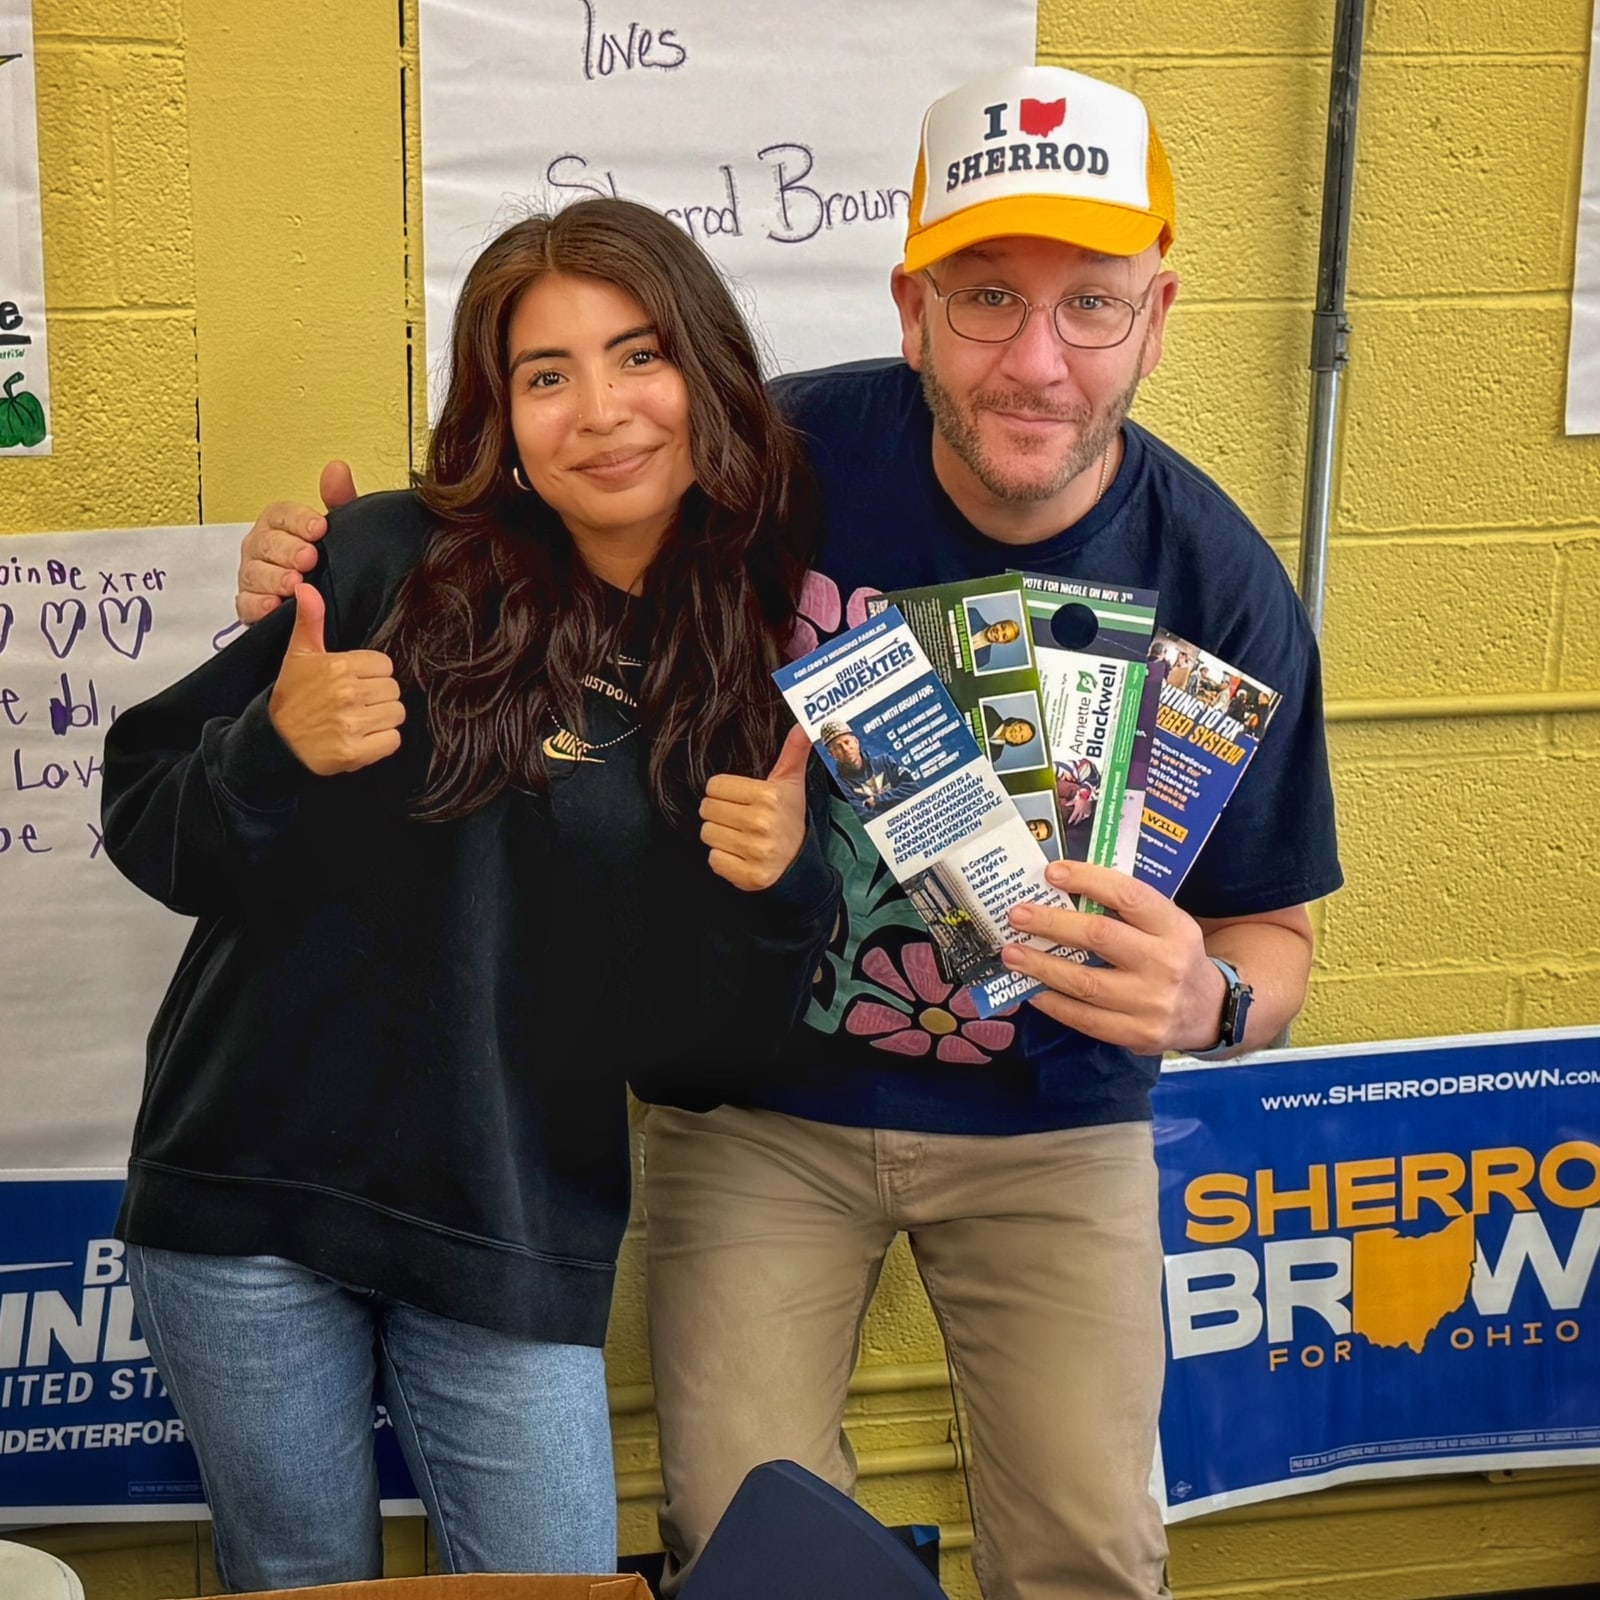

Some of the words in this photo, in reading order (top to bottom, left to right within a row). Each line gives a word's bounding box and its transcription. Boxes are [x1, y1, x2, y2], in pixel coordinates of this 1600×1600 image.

[577, 0, 687, 80] loves
[984, 103, 1008, 141] I
[946, 142, 1109, 192] SHERROD
[757, 144, 911, 244] Brown
[1022, 577, 1041, 590] VOTE
[1043, 580, 1059, 592] FOR
[1060, 582, 1087, 597] NICOLE
[1089, 587, 1101, 599] ON
[803, 642, 914, 721] POINDEXTER
[835, 656, 868, 684] BRIAN
[1069, 696, 1091, 755] Annette
[1086, 663, 1117, 758] Blackwell
[1216, 716, 1244, 741] FIX
[1189, 725, 1246, 766] SYSTEM
[14, 748, 105, 791] Lov
[983, 974, 1012, 995] VOTE
[986, 971, 1042, 1009] NOVEM
[83, 1238, 131, 1286] B
[1269, 1340, 1352, 1372] FOR
[1450, 1319, 1581, 1350] OHIO
[109, 1366, 169, 1401] ST
